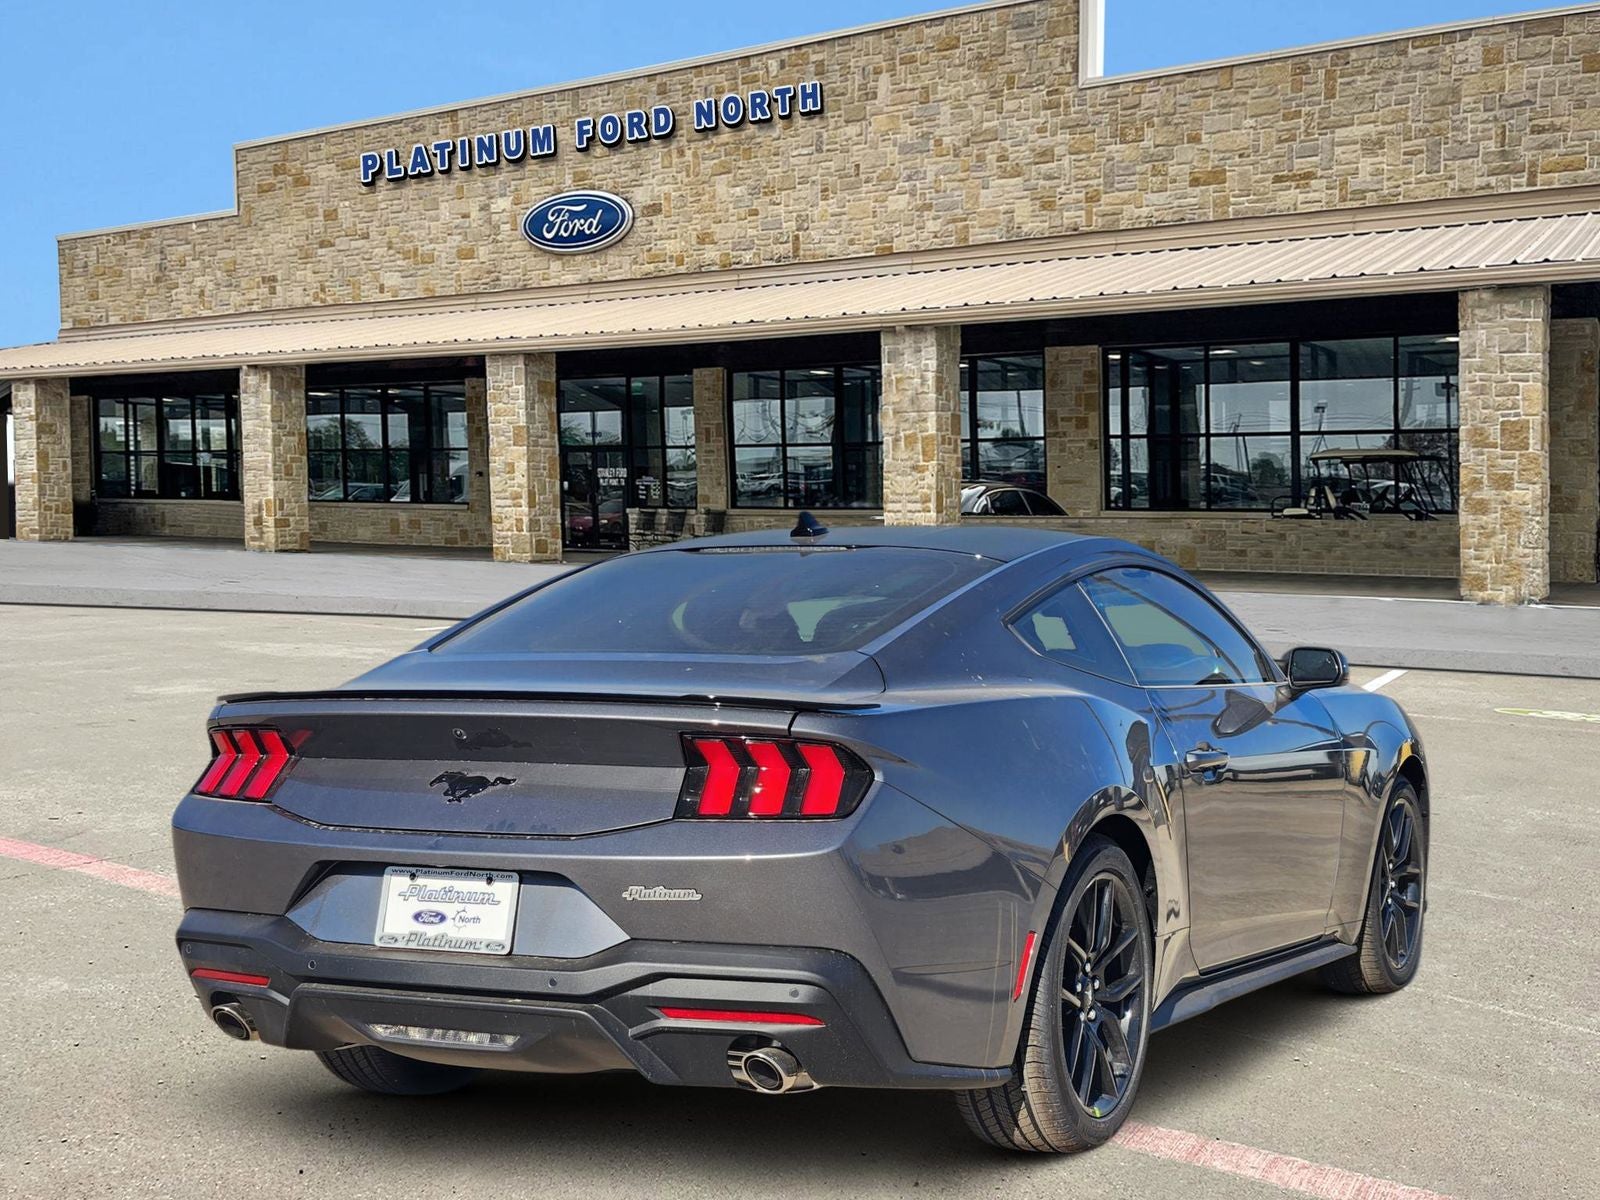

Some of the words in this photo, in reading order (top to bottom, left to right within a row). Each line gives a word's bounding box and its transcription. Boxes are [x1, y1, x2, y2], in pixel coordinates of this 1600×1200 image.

[360, 124, 556, 186] PLATINUM
[576, 105, 675, 152] FORD
[693, 81, 823, 132] NORTH
[541, 203, 603, 240] Ford
[391, 868, 513, 880] www.PlatinumFordNorth.com
[398, 883, 502, 906] Platinum
[622, 885, 703, 901] Platinum
[417, 911, 443, 925] Ford
[458, 915, 481, 925] North
[405, 931, 482, 950] Platinum
